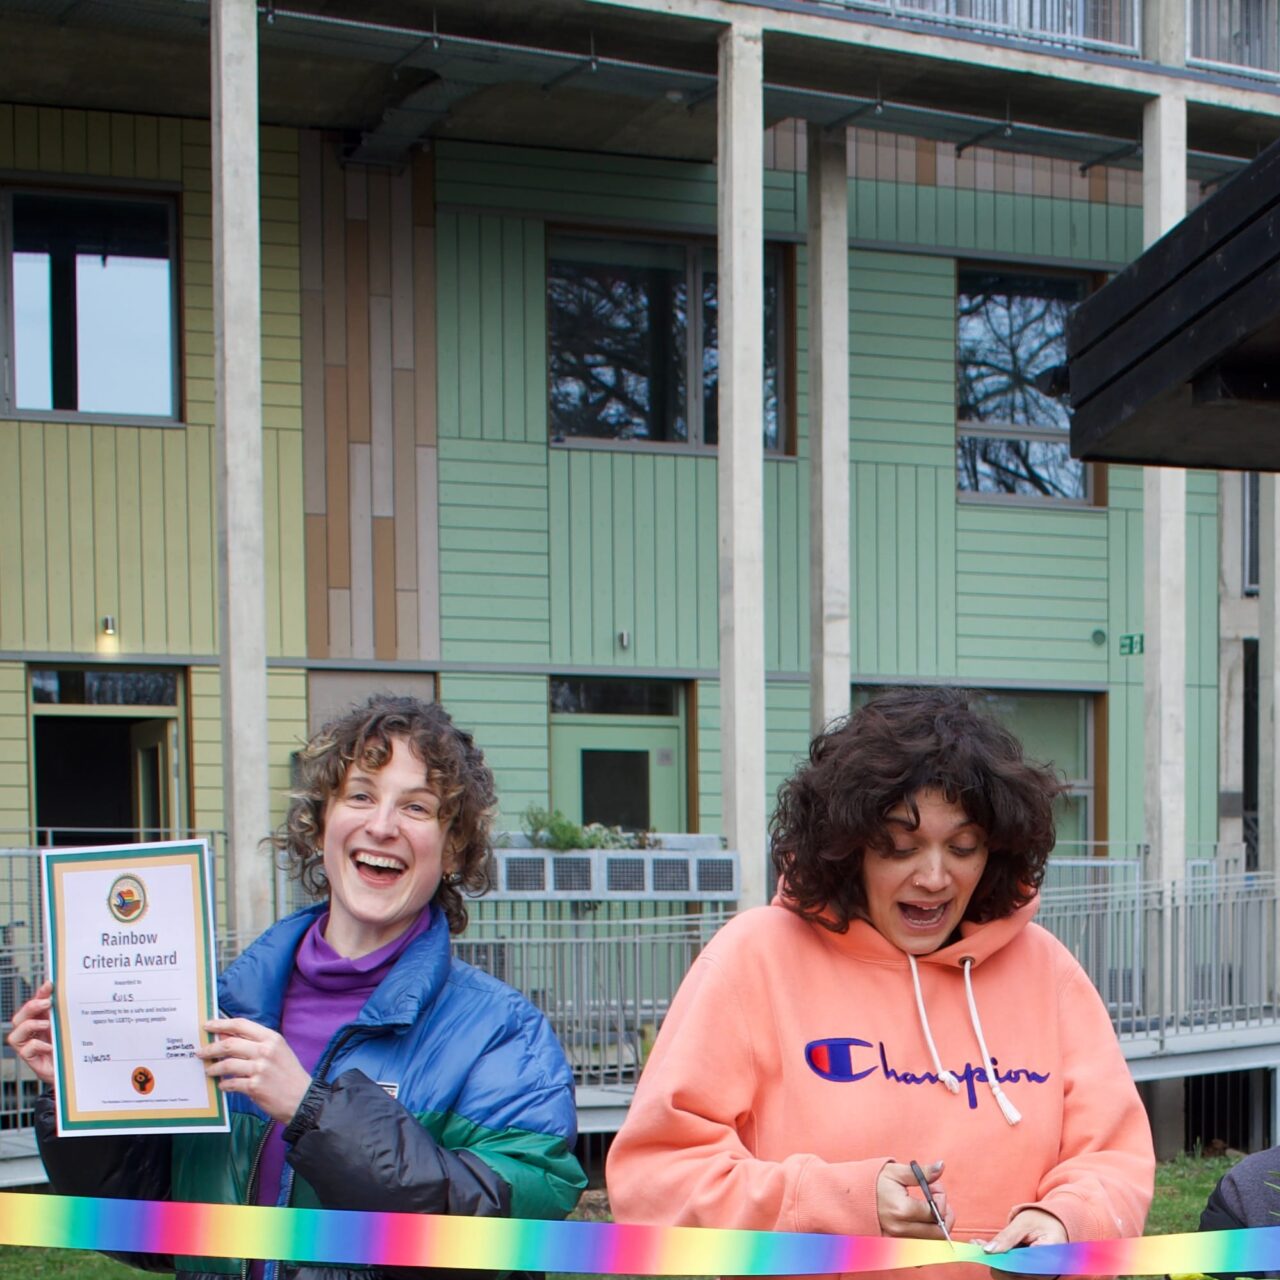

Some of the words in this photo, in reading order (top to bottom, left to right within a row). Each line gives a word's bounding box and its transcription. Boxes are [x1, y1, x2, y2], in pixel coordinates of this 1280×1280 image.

[101, 931, 158, 946] Rainbow
[82, 953, 131, 970] Criteria
[134, 951, 177, 967] Award
